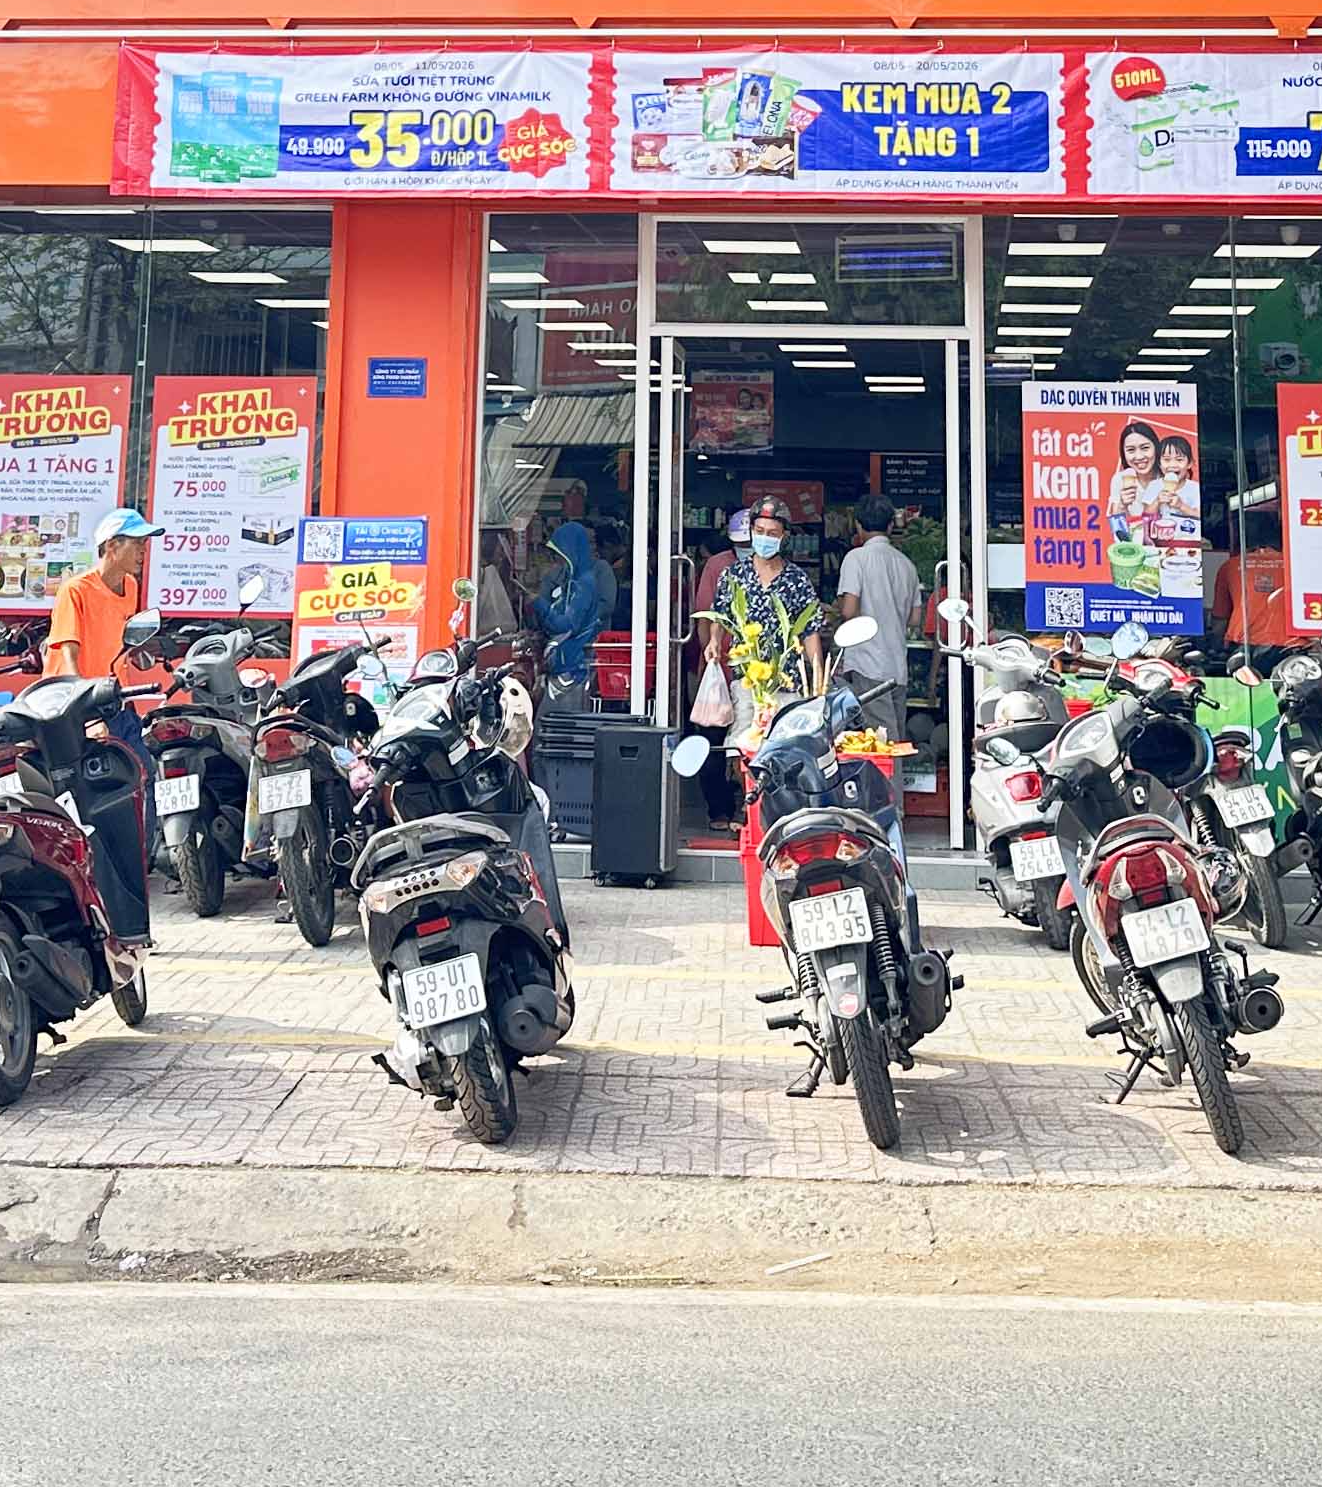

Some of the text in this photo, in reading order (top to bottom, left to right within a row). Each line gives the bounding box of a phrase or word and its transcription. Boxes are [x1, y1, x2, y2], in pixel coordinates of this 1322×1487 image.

[916, 60, 979, 73] 20/05/2026
[1114, 67, 1161, 89] 510ML
[294, 92, 338, 104] GREEN
[341, 91, 379, 103] FARM
[382, 88, 431, 103] KHÔNG
[486, 90, 551, 103] VINAMILK
[842, 82, 1013, 115] KEM MUA 2
[517, 123, 548, 142] GIÁ
[873, 121, 981, 166] TẶNG 1
[497, 137, 576, 163] CỰC SỐC
[1246, 138, 1311, 160] 115.000
[13, 390, 82, 414] KHAI
[199, 392, 269, 416] KHAI
[171, 412, 294, 439] TRƯƠNG
[1066, 427, 1093, 457] cả
[27, 457, 38, 473] 1
[43, 454, 97, 478] TẶNG
[105, 458, 115, 473] 1
[173, 480, 227, 498] 75.000
[1032, 462, 1100, 500] kem
[1033, 504, 1101, 530] mua 2
[163, 534, 230, 553] 579.000
[1034, 535, 1102, 568] tặng 1
[341, 567, 378, 588] GIÁ
[159, 587, 227, 606] 397.000
[310, 582, 407, 614] CỰC SỐC
[801, 893, 859, 924] 59-L2
[801, 915, 867, 948] 843.95
[415, 961, 469, 996] 59-U1
[414, 984, 481, 1024] 987.80
